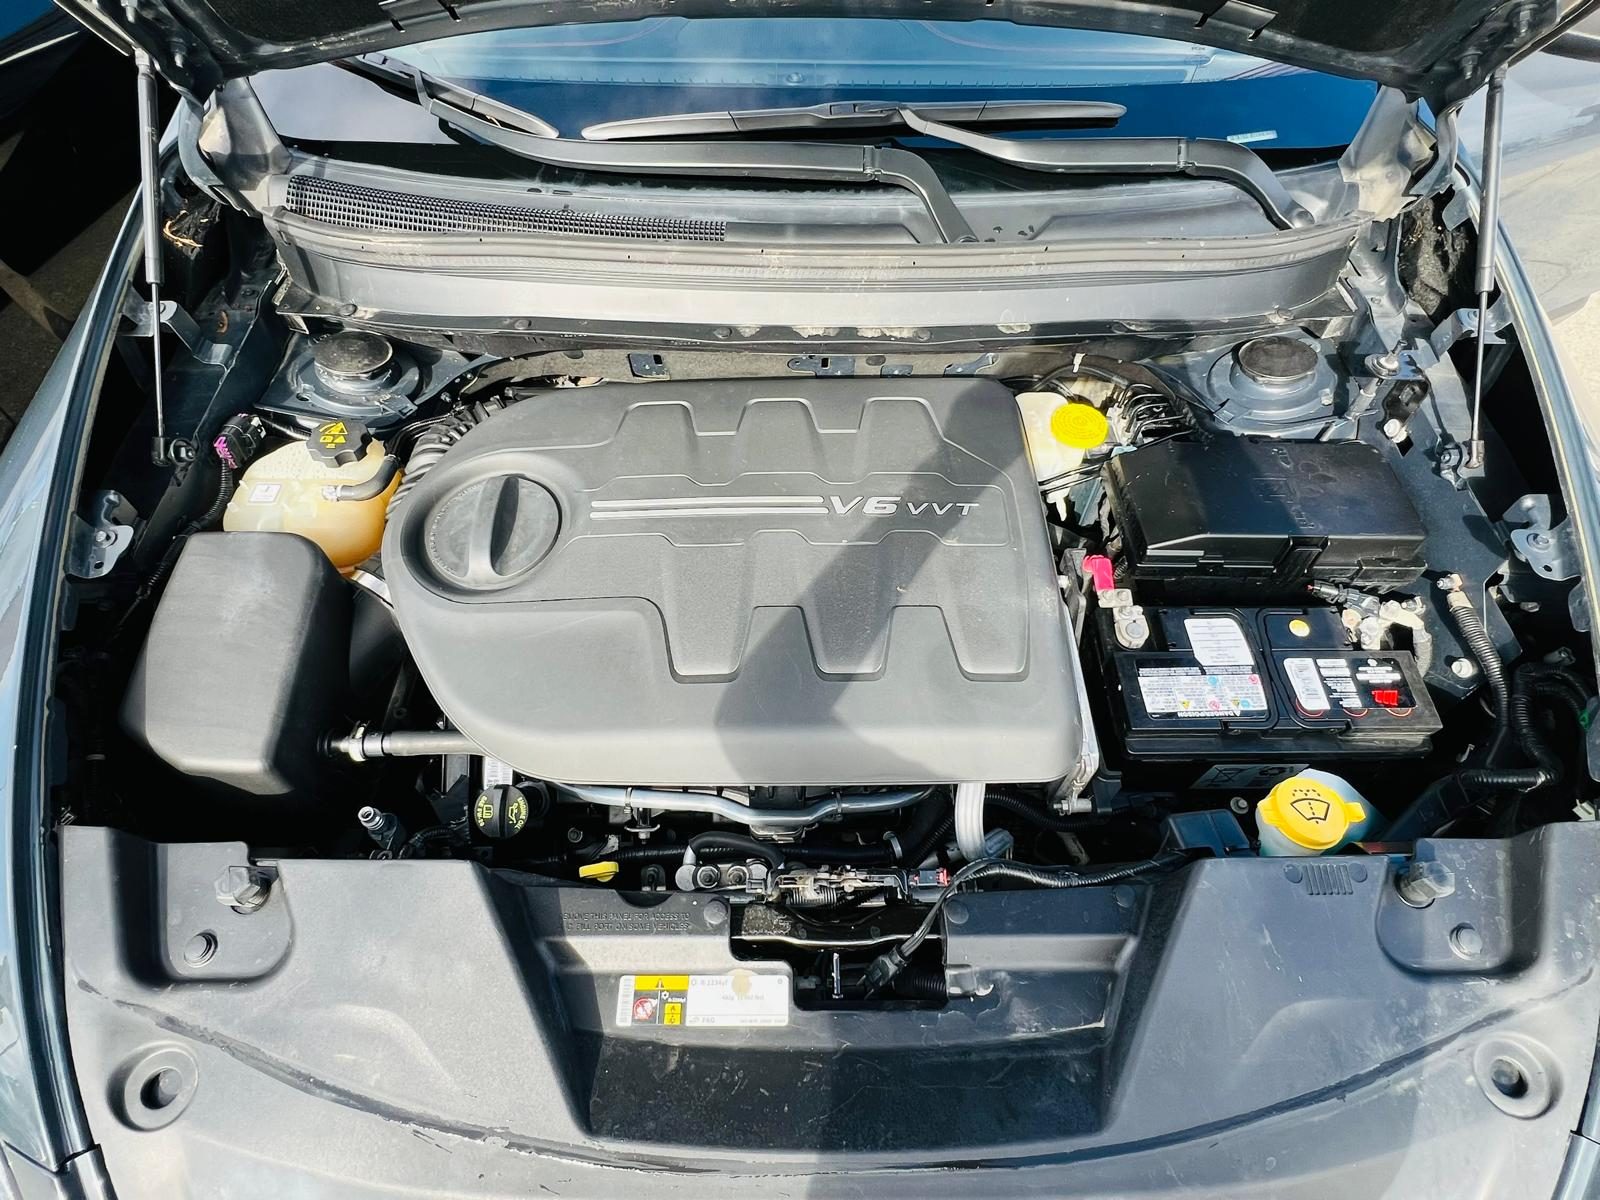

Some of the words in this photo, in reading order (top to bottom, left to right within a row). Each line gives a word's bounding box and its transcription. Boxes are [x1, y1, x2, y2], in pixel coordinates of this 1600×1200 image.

[829, 496, 902, 515] V6
[906, 502, 980, 516] VVT
[517, 796, 527, 819] ENGINE
[514, 819, 524, 830] OIL
[590, 912, 608, 921] THIS
[634, 912, 649, 921] FOR
